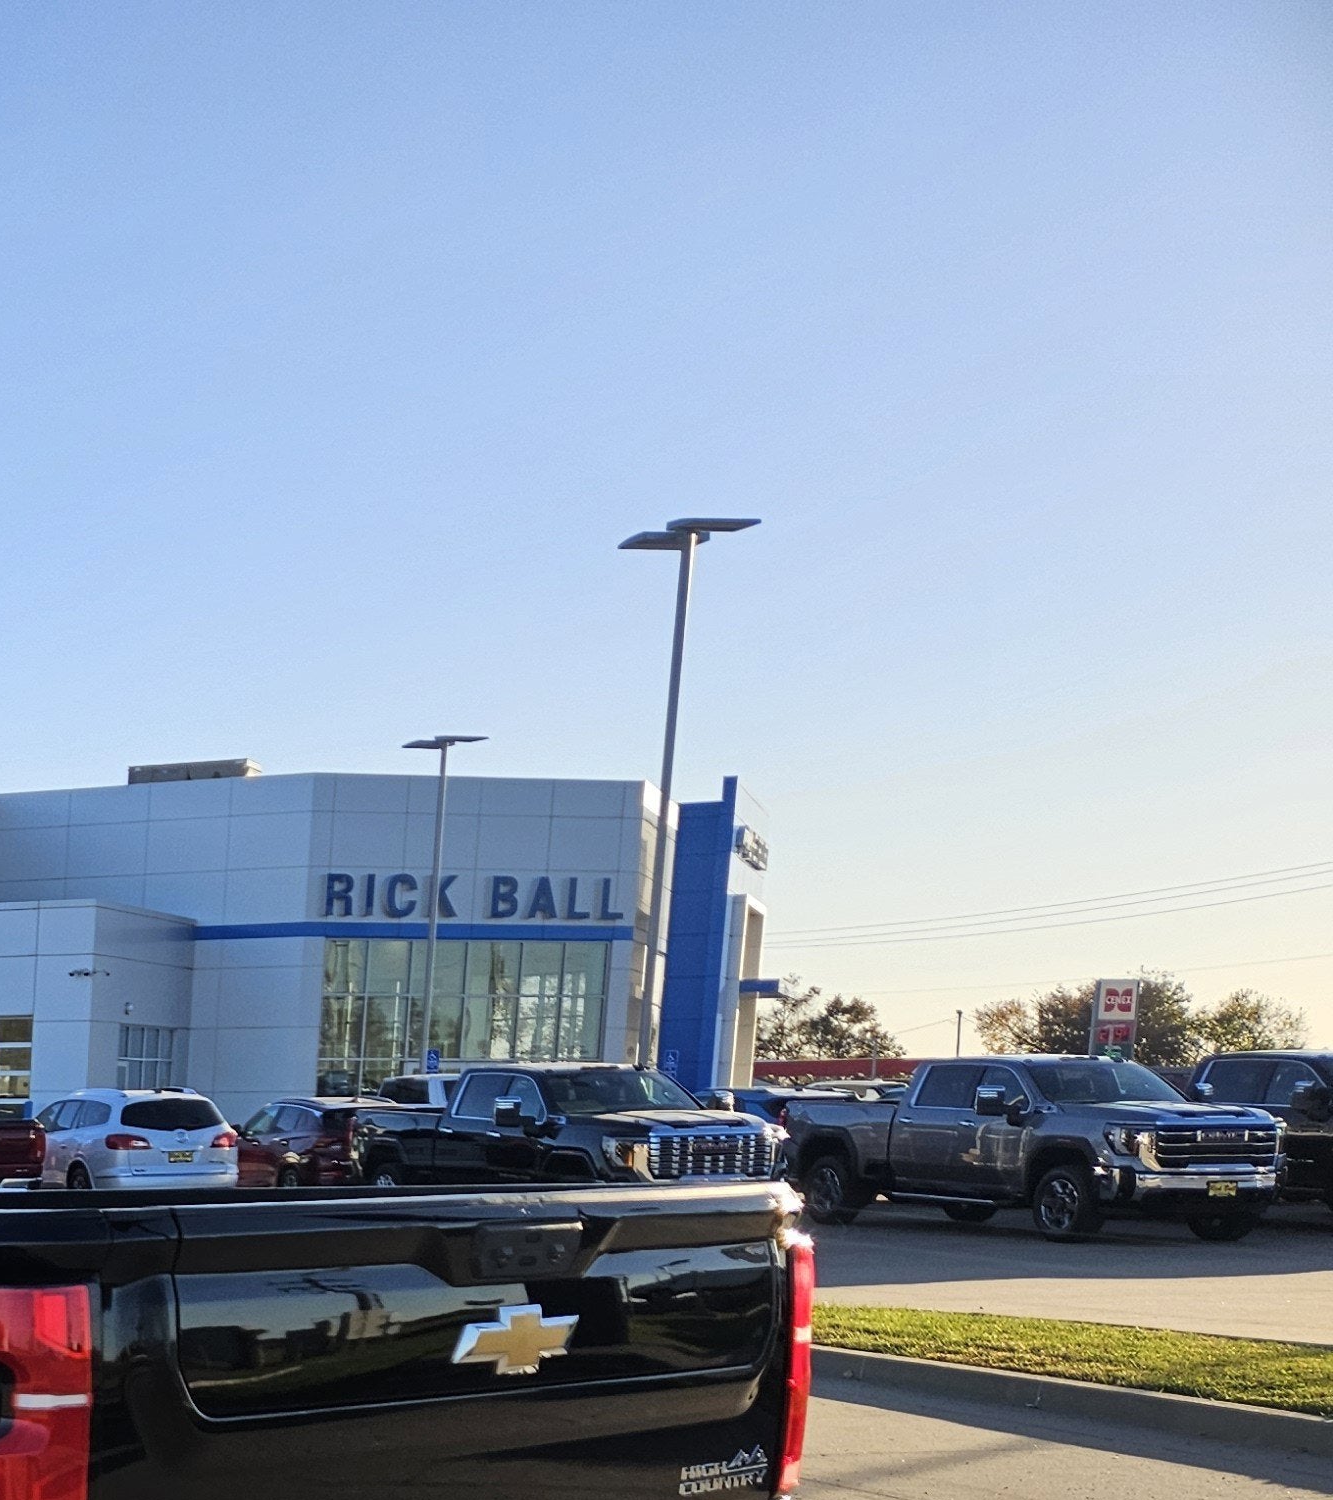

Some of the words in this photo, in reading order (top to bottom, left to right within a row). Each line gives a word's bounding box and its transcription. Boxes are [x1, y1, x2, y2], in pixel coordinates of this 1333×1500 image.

[323, 873, 459, 917] RICK
[490, 875, 624, 920] BALL
[1105, 995, 1133, 1005] CENEX
[680, 1460, 729, 1480] HIGH
[678, 1468, 768, 1497] COUNTRY
